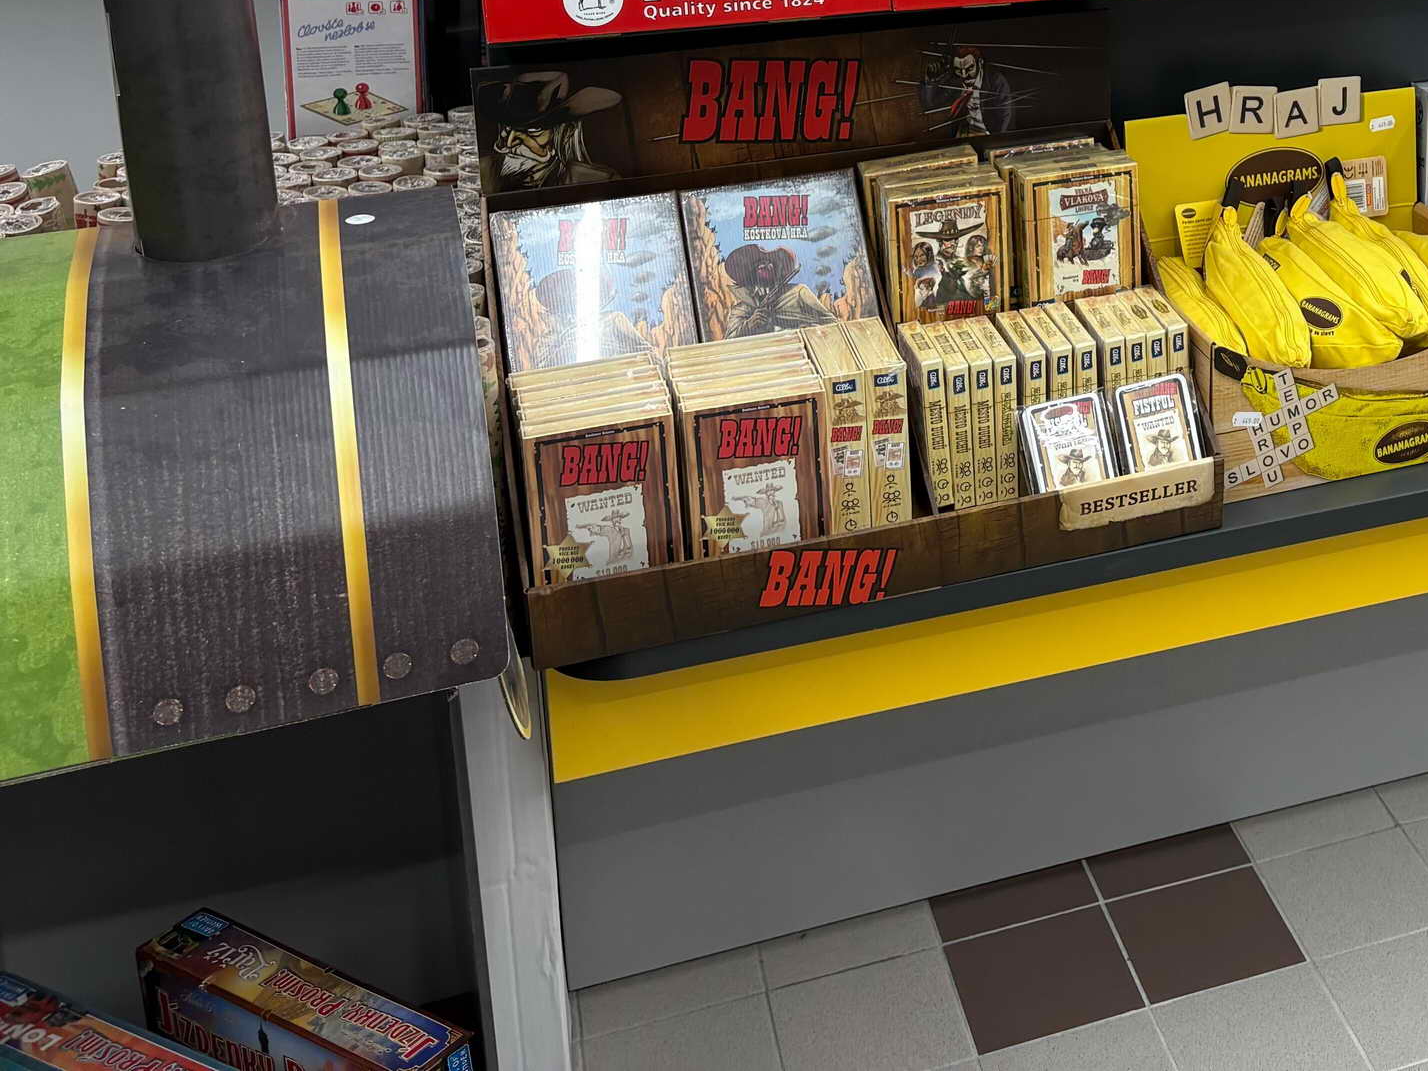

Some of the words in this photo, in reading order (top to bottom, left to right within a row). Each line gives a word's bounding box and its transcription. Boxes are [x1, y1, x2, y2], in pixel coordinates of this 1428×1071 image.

[644, 1, 719, 19] Quality
[684, 60, 860, 143] BANG!
[1196, 87, 1347, 128] HRAJ
[1234, 166, 1318, 187] ANANAGRAMS
[743, 195, 809, 227] BANG!
[914, 204, 982, 228] LEGENDY
[1064, 192, 1104, 208] VLAKOVÁ
[787, 227, 808, 239] HRA
[1134, 396, 1174, 415] FISTFUL
[1254, 389, 1333, 435] HUMOR
[1279, 373, 1309, 450] TEMPO
[718, 416, 801, 459] BANG!
[1254, 425, 1278, 482] HROU
[561, 440, 649, 486] BANG!
[733, 467, 787, 488] WANTED
[1228, 438, 1309, 484] SLOVO
[1080, 480, 1198, 515] BESTSELLER
[760, 550, 897, 608] BANG!
